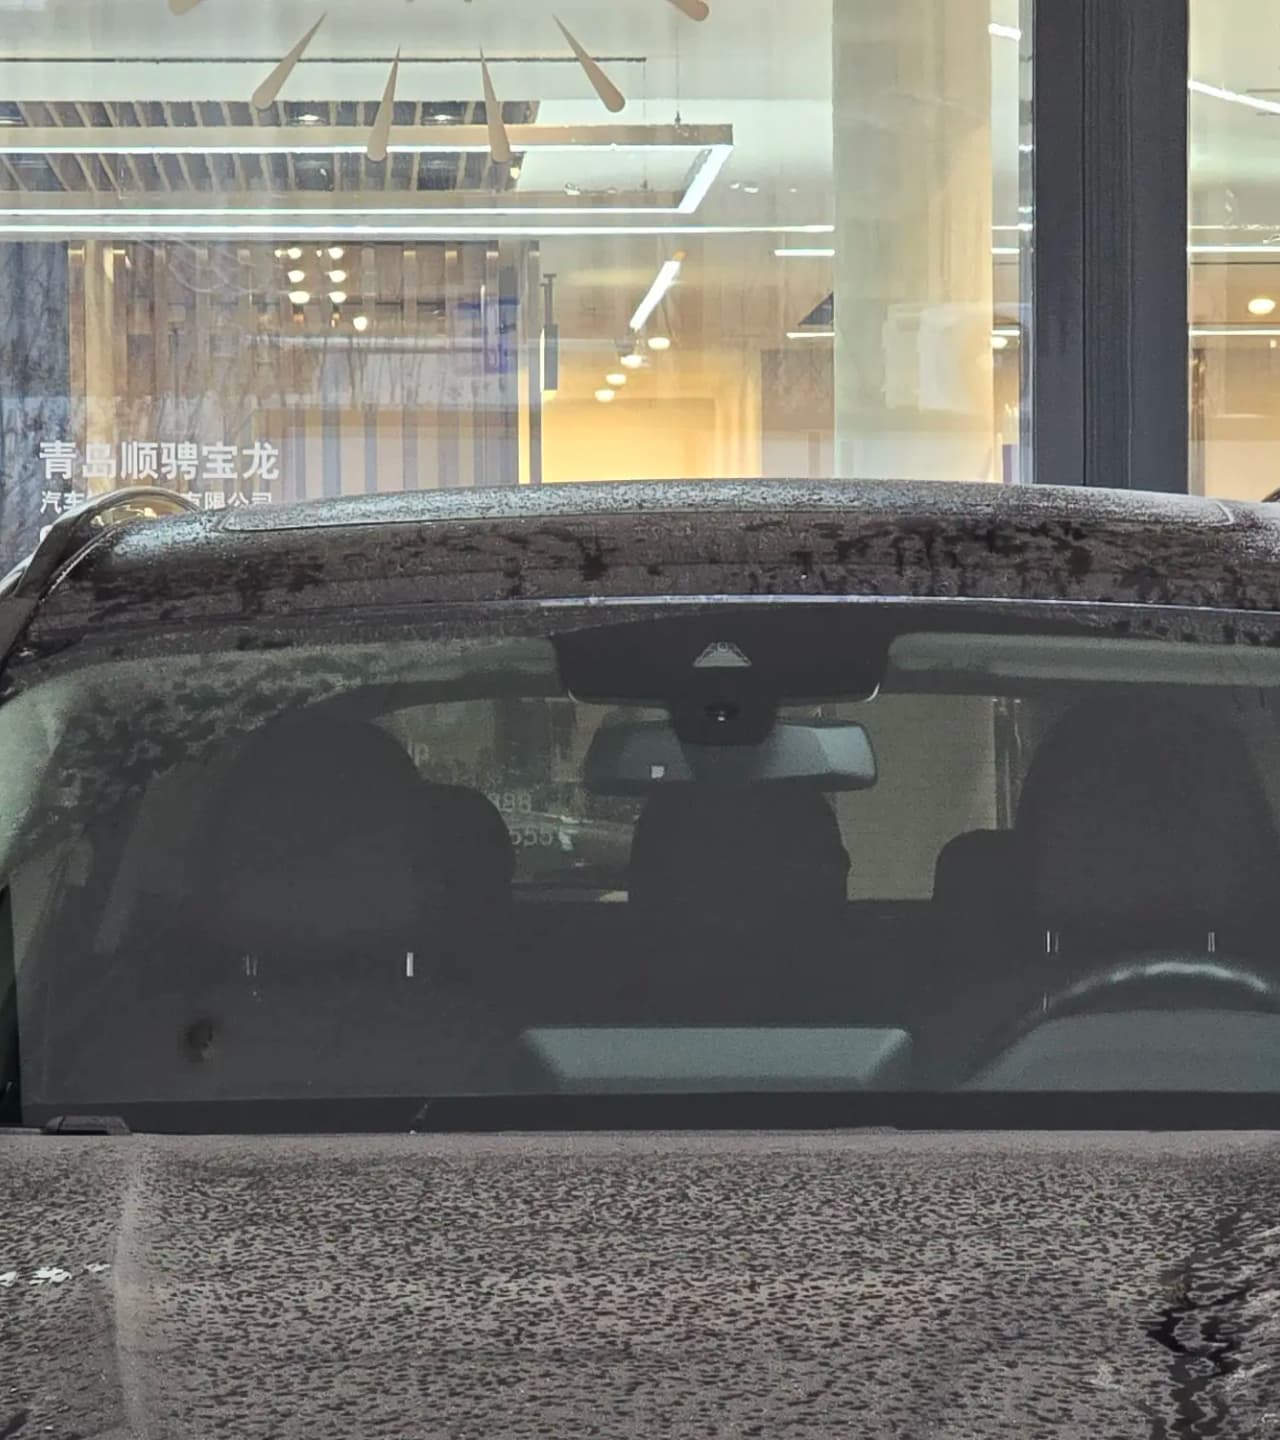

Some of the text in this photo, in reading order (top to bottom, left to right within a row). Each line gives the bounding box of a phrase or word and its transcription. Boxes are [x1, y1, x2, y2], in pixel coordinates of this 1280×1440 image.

[39, 440, 280, 480] 青岛顺骋宝龙
